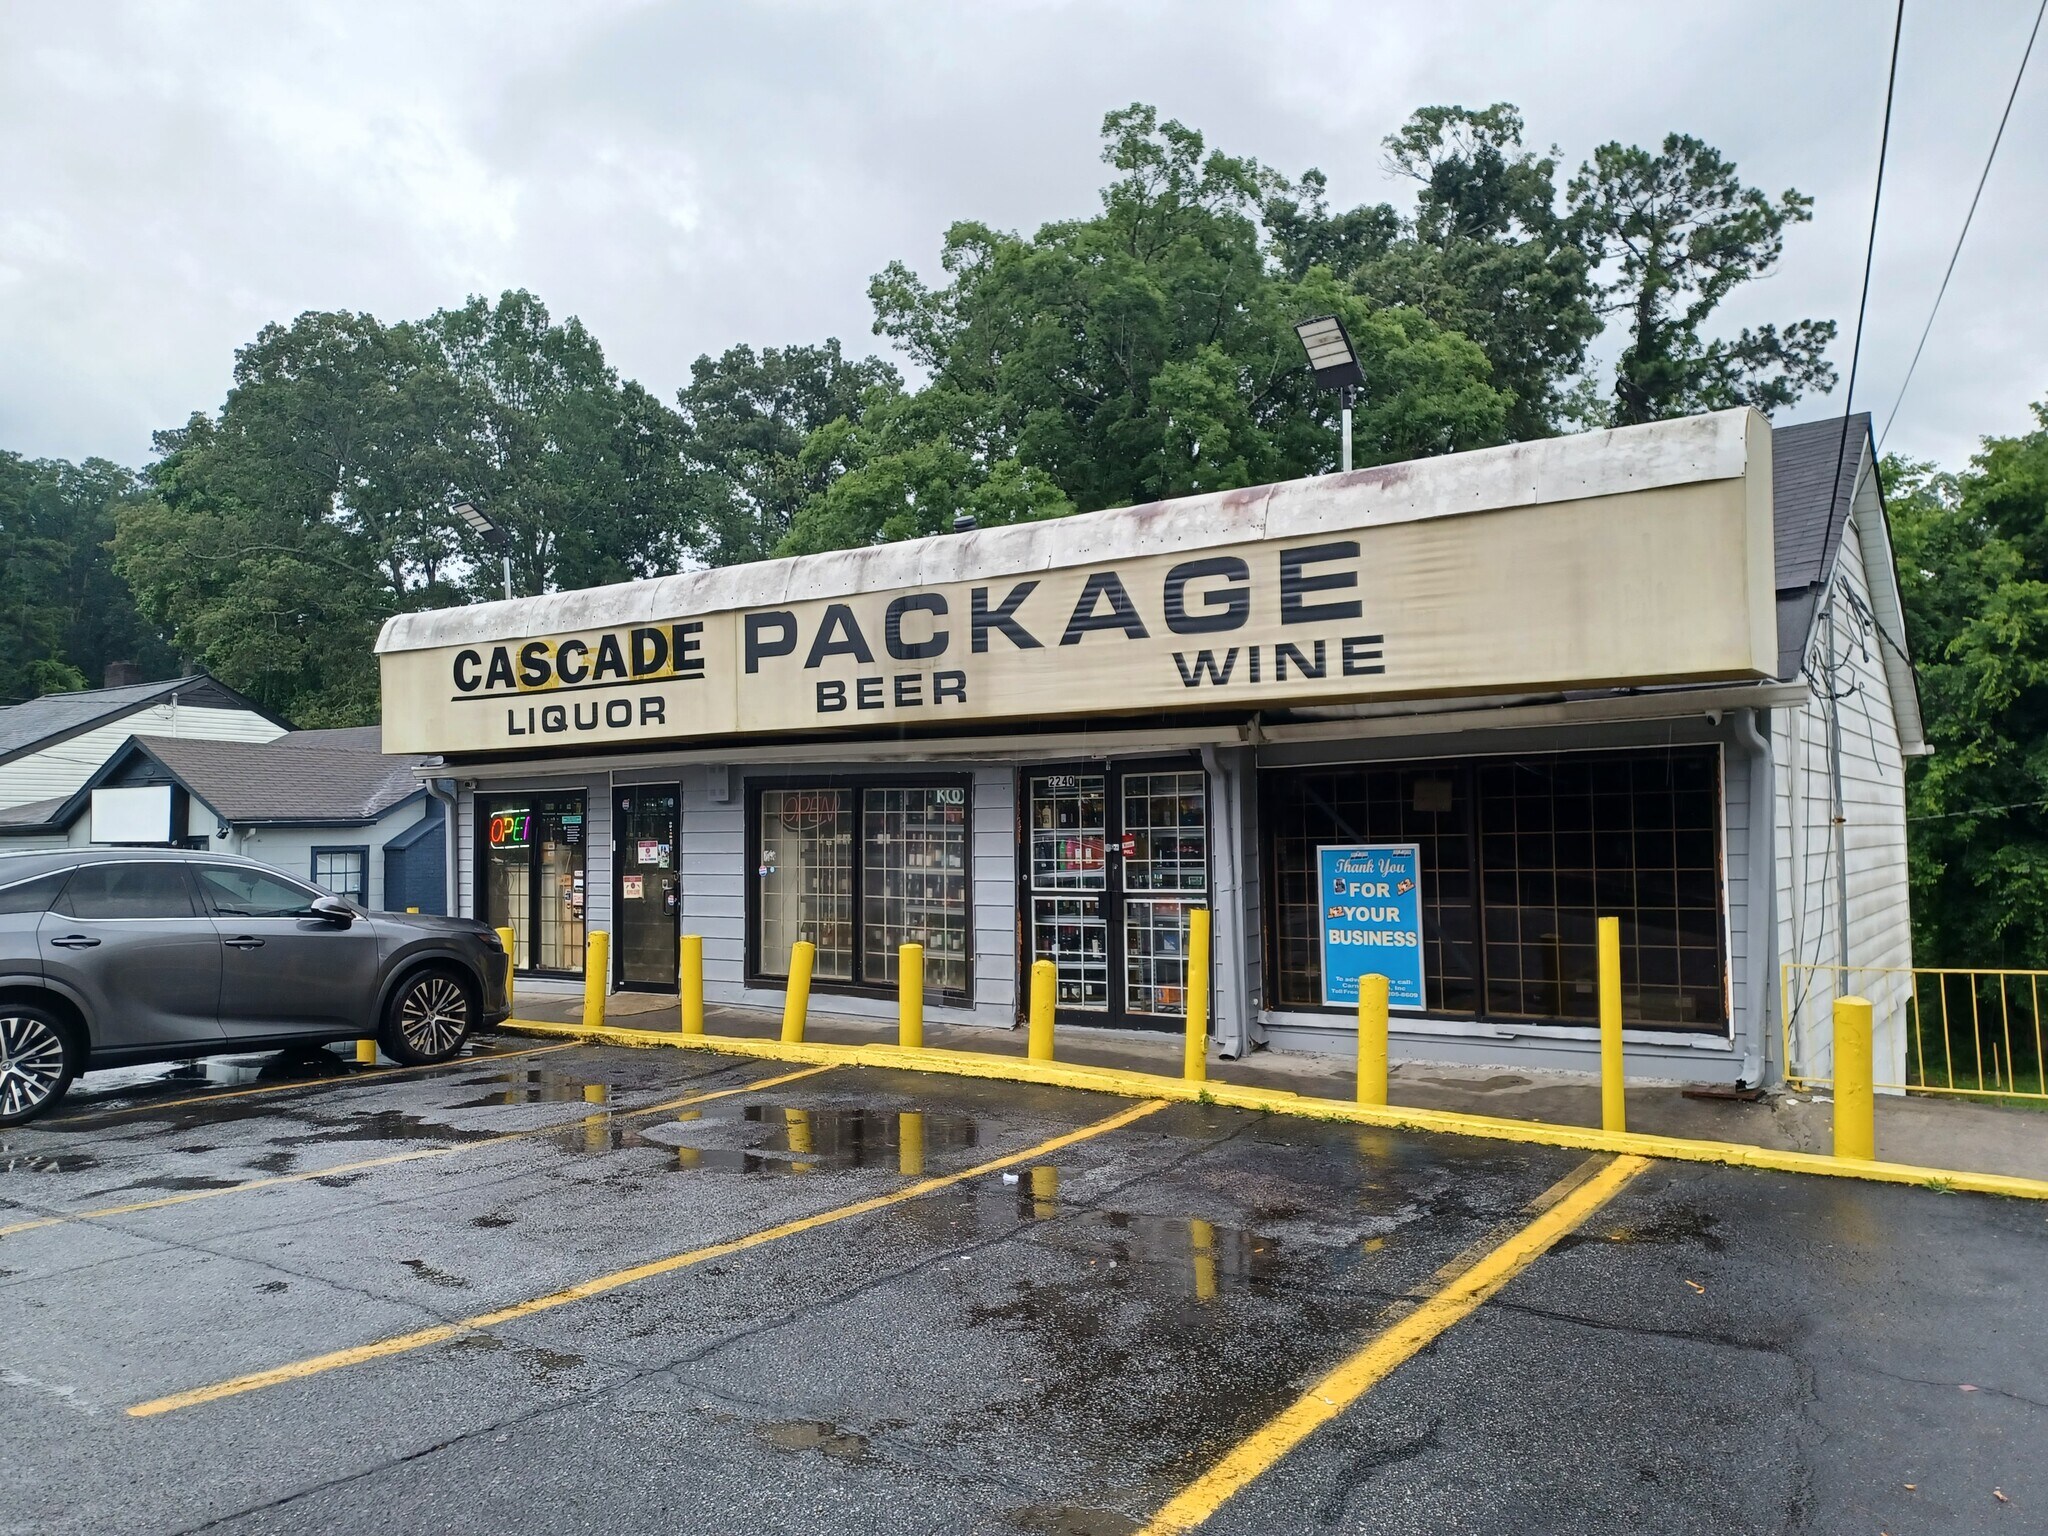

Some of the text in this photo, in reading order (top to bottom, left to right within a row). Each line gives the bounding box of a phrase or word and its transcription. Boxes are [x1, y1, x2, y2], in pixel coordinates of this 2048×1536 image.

[745, 541, 1362, 674] PACKAGE
[453, 620, 705, 693] CASCADE
[1172, 634, 1385, 688] WINE
[817, 670, 967, 713] BEER
[508, 695, 666, 736] LIQUOR
[1049, 776, 1074, 786] 2240
[783, 796, 837, 822] OPEN
[1334, 858, 1406, 878] Thank You
[1349, 882, 1391, 898] FOR
[1343, 906, 1401, 922] YOUR
[1329, 929, 1418, 947] BUSINESS
